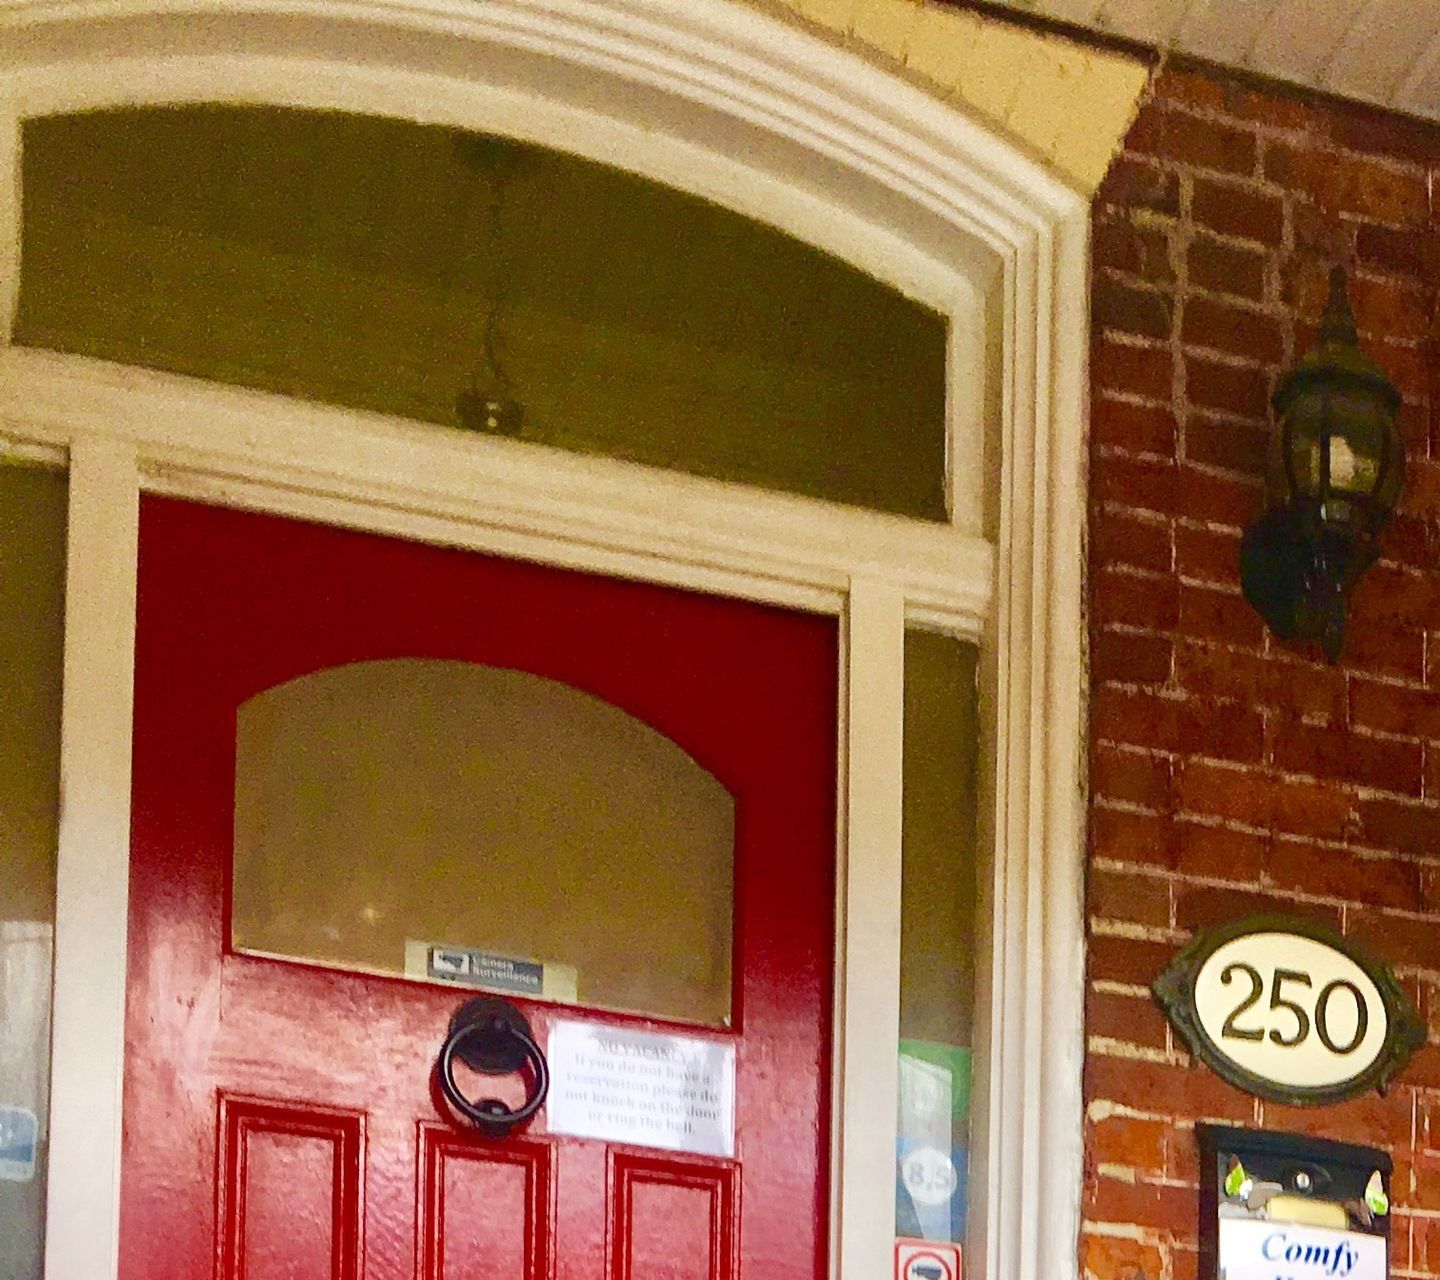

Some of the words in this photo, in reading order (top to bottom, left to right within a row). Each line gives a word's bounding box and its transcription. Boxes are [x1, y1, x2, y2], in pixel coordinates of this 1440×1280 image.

[1220, 962, 1368, 1055] 250
[588, 1057, 614, 1072] you
[618, 1061, 636, 1074] do
[639, 1064, 662, 1078] not
[666, 1066, 700, 1083] have
[566, 1071, 649, 1094] reservation
[652, 1082, 697, 1101] please
[700, 1088, 719, 1103] do
[565, 1088, 588, 1102] not
[592, 1089, 635, 1110] knock
[638, 1099, 657, 1112] on
[659, 1100, 682, 1115] the
[685, 1103, 721, 1120] door
[587, 1110, 602, 1122] or
[606, 1112, 636, 1129] ring
[640, 1114, 663, 1130] the
[1262, 1231, 1359, 1279] Comfy
